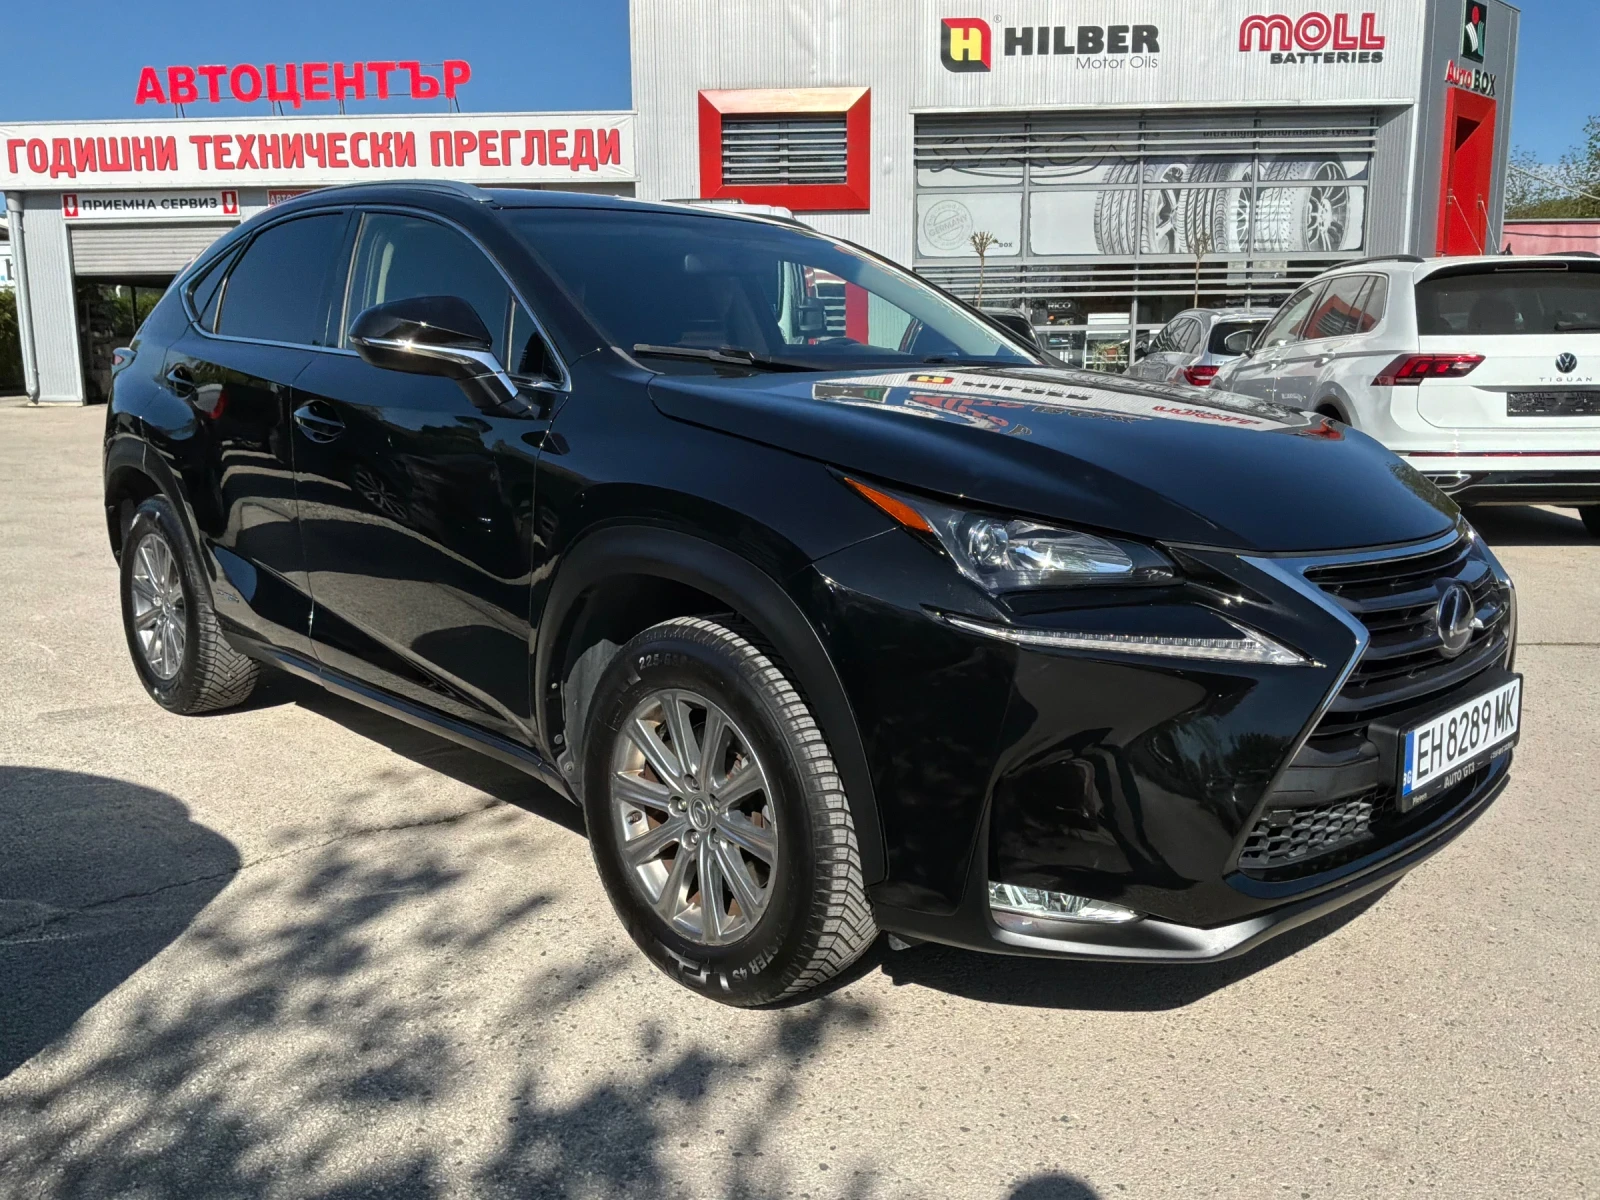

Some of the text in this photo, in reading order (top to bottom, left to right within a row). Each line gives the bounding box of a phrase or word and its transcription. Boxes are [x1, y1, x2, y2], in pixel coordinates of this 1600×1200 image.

[1005, 24, 1160, 56] HILBER
[1076, 56, 1158, 70] Motor Oils
[1270, 50, 1384, 65] BATTERIES
[135, 59, 472, 108] АВТОЦЕНТЪР
[7, 128, 621, 178] ГОДИШНИ ТЕХНИЧЕСКИ ПРЕГЛЕДИ
[82, 197, 218, 211] ПРИЕМНА СЕРВИЗ
[929, 214, 968, 236] GERMANY
